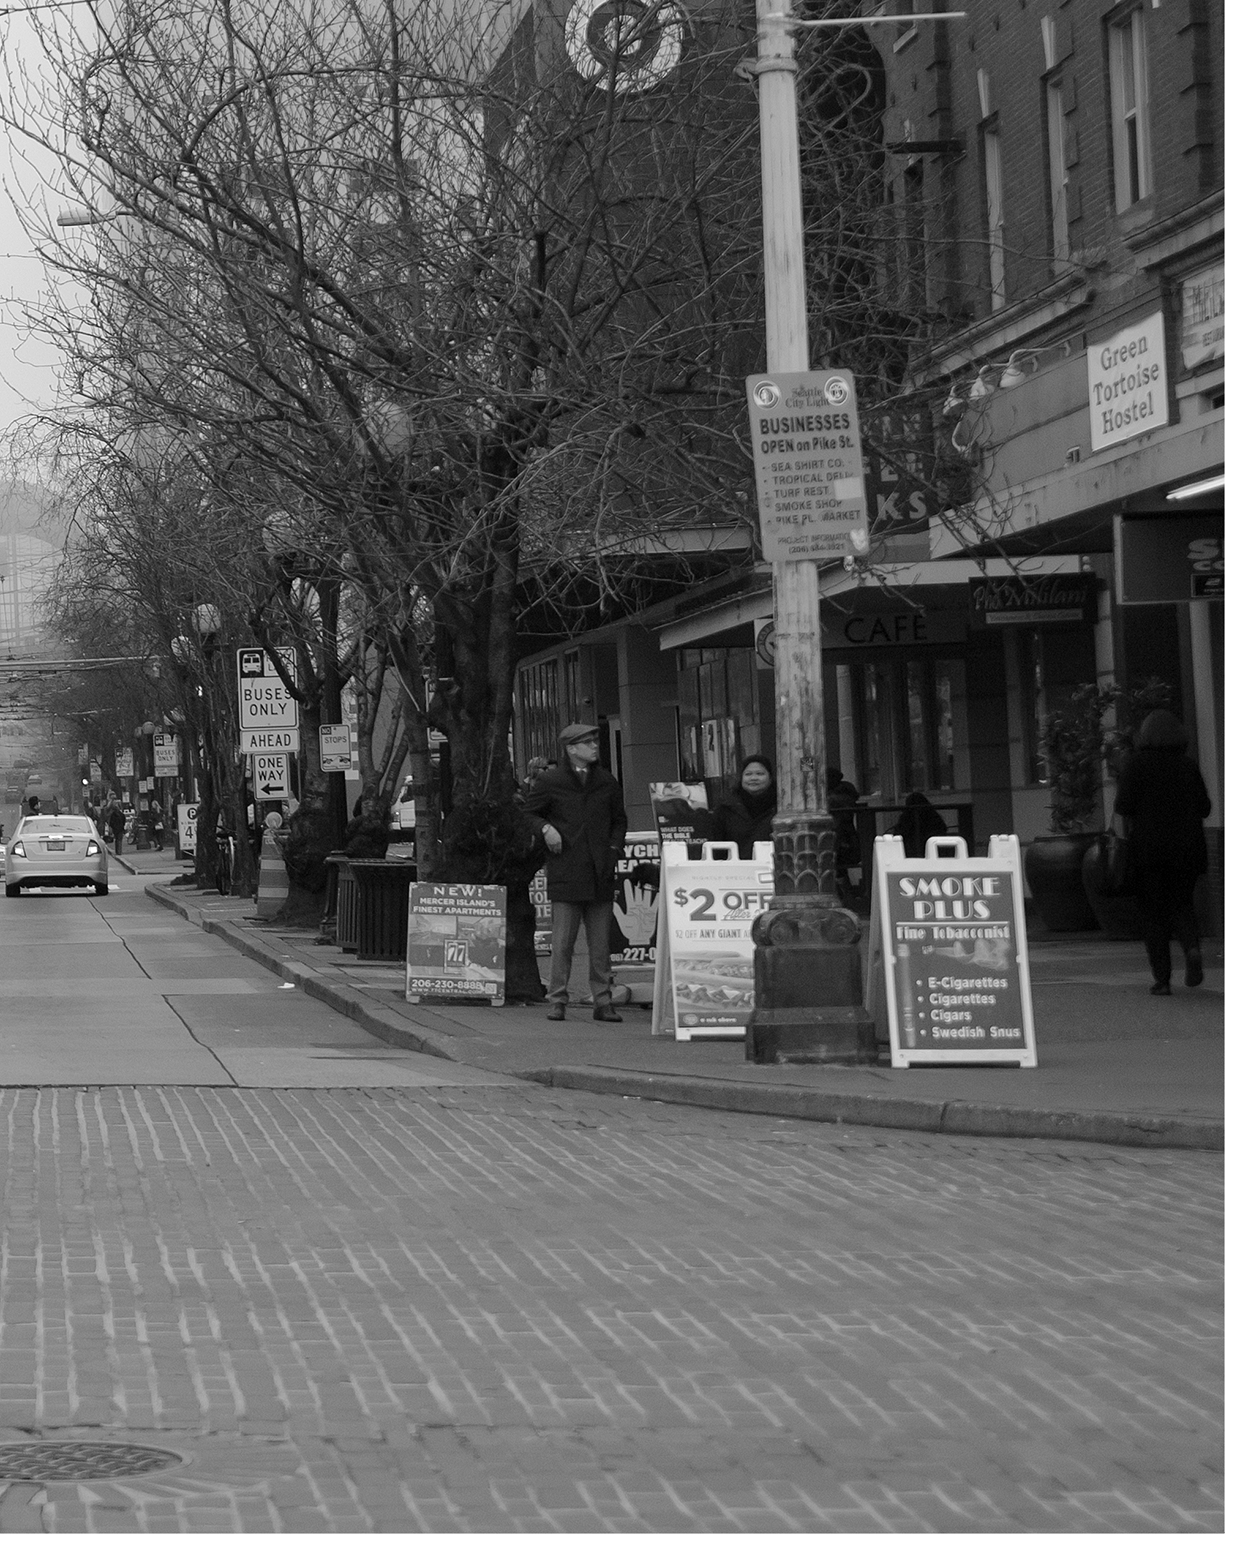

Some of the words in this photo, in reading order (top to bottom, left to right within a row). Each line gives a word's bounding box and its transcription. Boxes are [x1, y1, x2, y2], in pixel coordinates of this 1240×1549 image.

[1100, 335, 1148, 371] Green
[791, 385, 823, 397] Seattle
[1093, 362, 1159, 406] Tortoise
[785, 398, 804, 409] City
[1101, 391, 1154, 435] Hostel
[760, 413, 850, 435] BUSINESSES
[760, 439, 794, 454] OPEN
[796, 440, 810, 451] on
[812, 436, 836, 451] Pike
[771, 462, 791, 472] SEA
[794, 459, 824, 470] SHIRT
[772, 472, 823, 485] TROPICAL
[774, 488, 801, 499] TURF
[775, 500, 811, 513] SMOKE
[775, 515, 797, 525] PIKE
[821, 509, 860, 521] MARKET
[844, 615, 927, 643] CAFE
[244, 687, 292, 701] BUSES
[250, 703, 287, 716] ONLY
[250, 734, 292, 748] AHEAD
[324, 736, 347, 744] STOPS
[258, 757, 283, 769] ONE
[258, 769, 284, 781] WAY
[433, 886, 482, 897] NEW!
[899, 877, 1000, 896] SMOKE
[420, 897, 455, 906] MERCER
[457, 898, 495, 907] ISLAND'S
[674, 887, 717, 922] $2
[723, 892, 773, 910] OFF
[413, 906, 443, 914] FINEST
[445, 907, 502, 916] APARTMENTS
[914, 900, 991, 919] PLUS
[684, 929, 698, 938] OFF
[700, 929, 715, 938] ANY
[718, 929, 741, 938] GIANT
[896, 927, 926, 940] Fine
[932, 926, 1010, 940] Tobacconist
[447, 943, 465, 962] 77
[928, 977, 1009, 990] E-Cigarettes
[929, 993, 997, 1007] Cigarettes
[930, 1009, 973, 1024] Cigars
[932, 1026, 985, 1040] Swedish
[990, 1026, 1021, 1038] Snus
